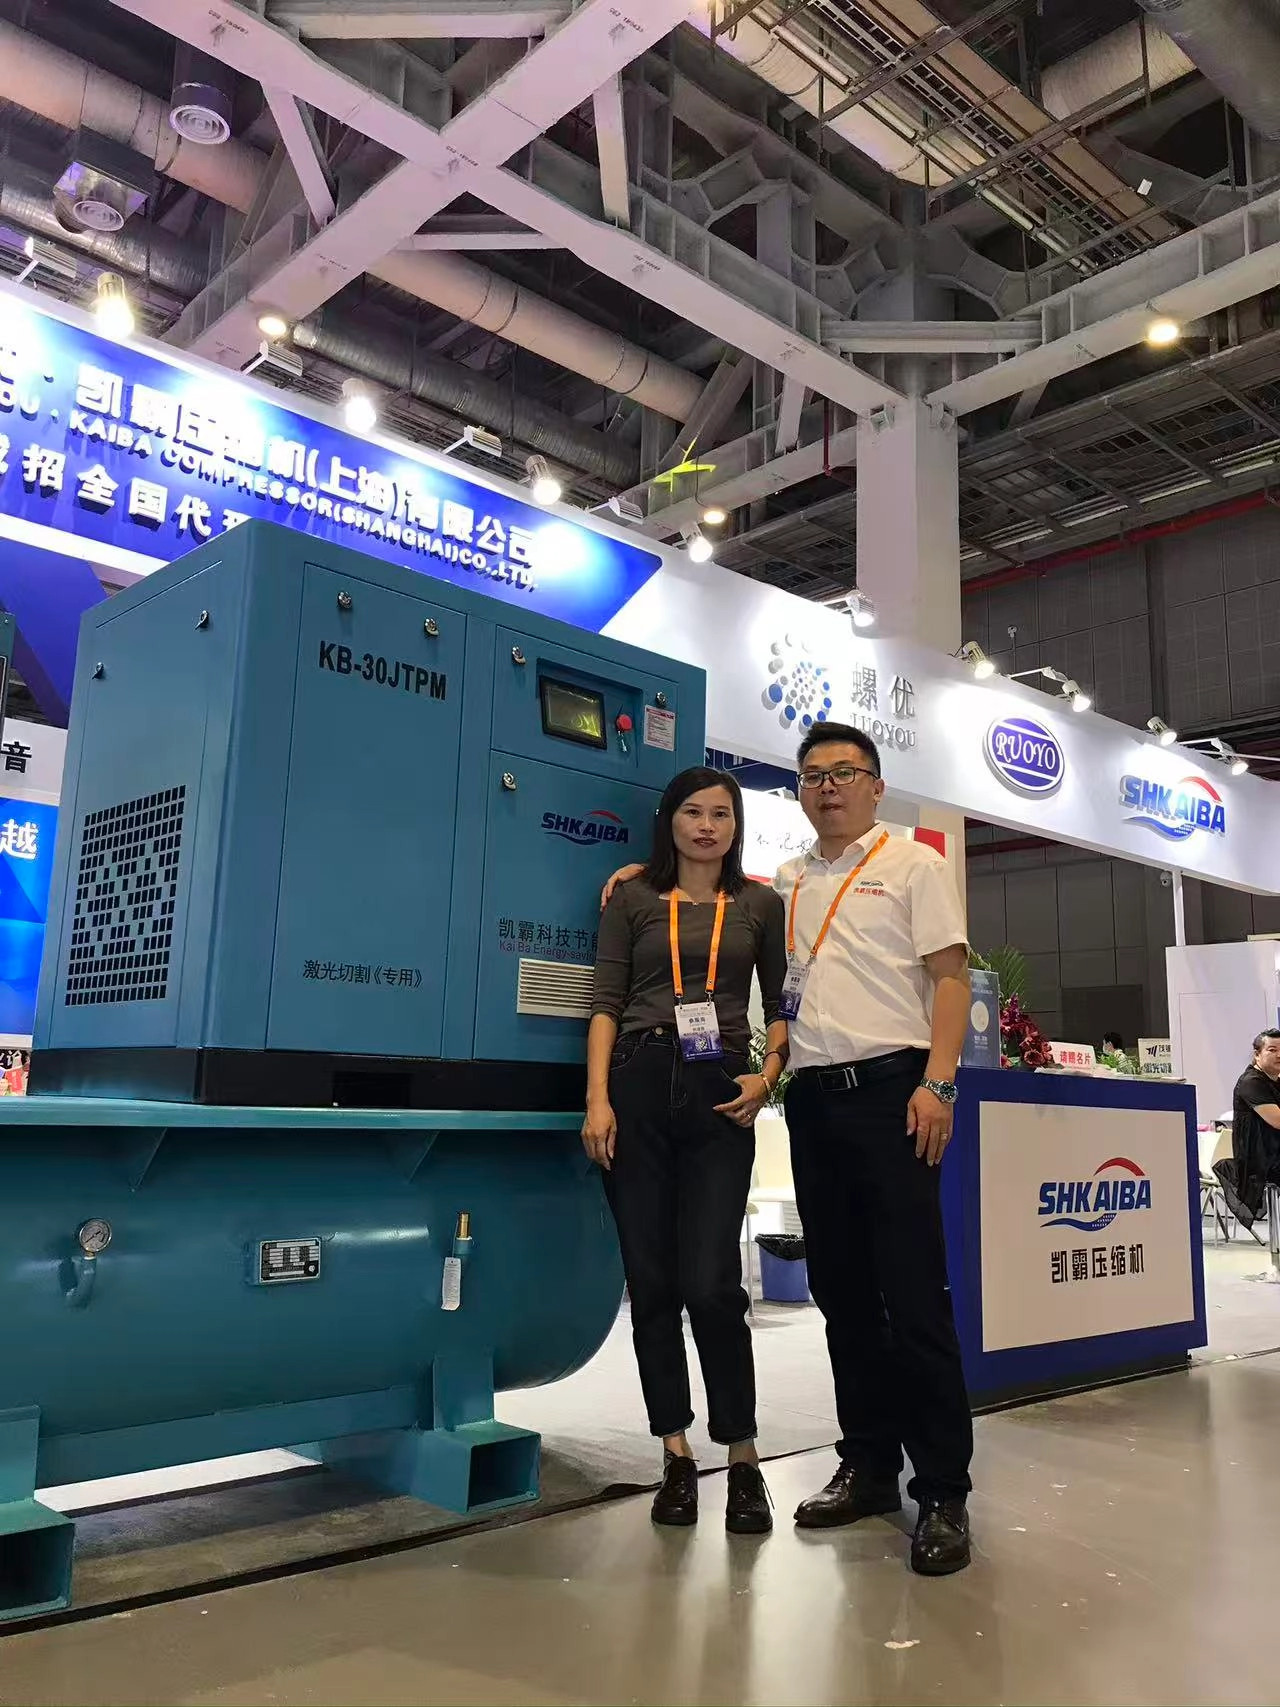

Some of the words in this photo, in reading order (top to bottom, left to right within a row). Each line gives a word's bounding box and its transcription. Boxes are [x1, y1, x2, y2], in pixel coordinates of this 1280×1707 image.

[69, 410, 153, 454] KAIBA
[0, 433, 252, 537] 招全国代
[319, 640, 447, 701] KB-30JTPM
[851, 662, 915, 720] 螺优
[0, 741, 32, 773] 音
[995, 731, 1056, 770] RUOYO
[1121, 775, 1226, 834] SHKAIBA
[0, 818, 39, 860] 越
[541, 811, 629, 845] SHKAIBA
[302, 960, 423, 988] 激光切割《专用》
[1038, 1180, 1152, 1215] SHKAIBA
[1051, 1243, 1145, 1284] 凯霸压缩机
